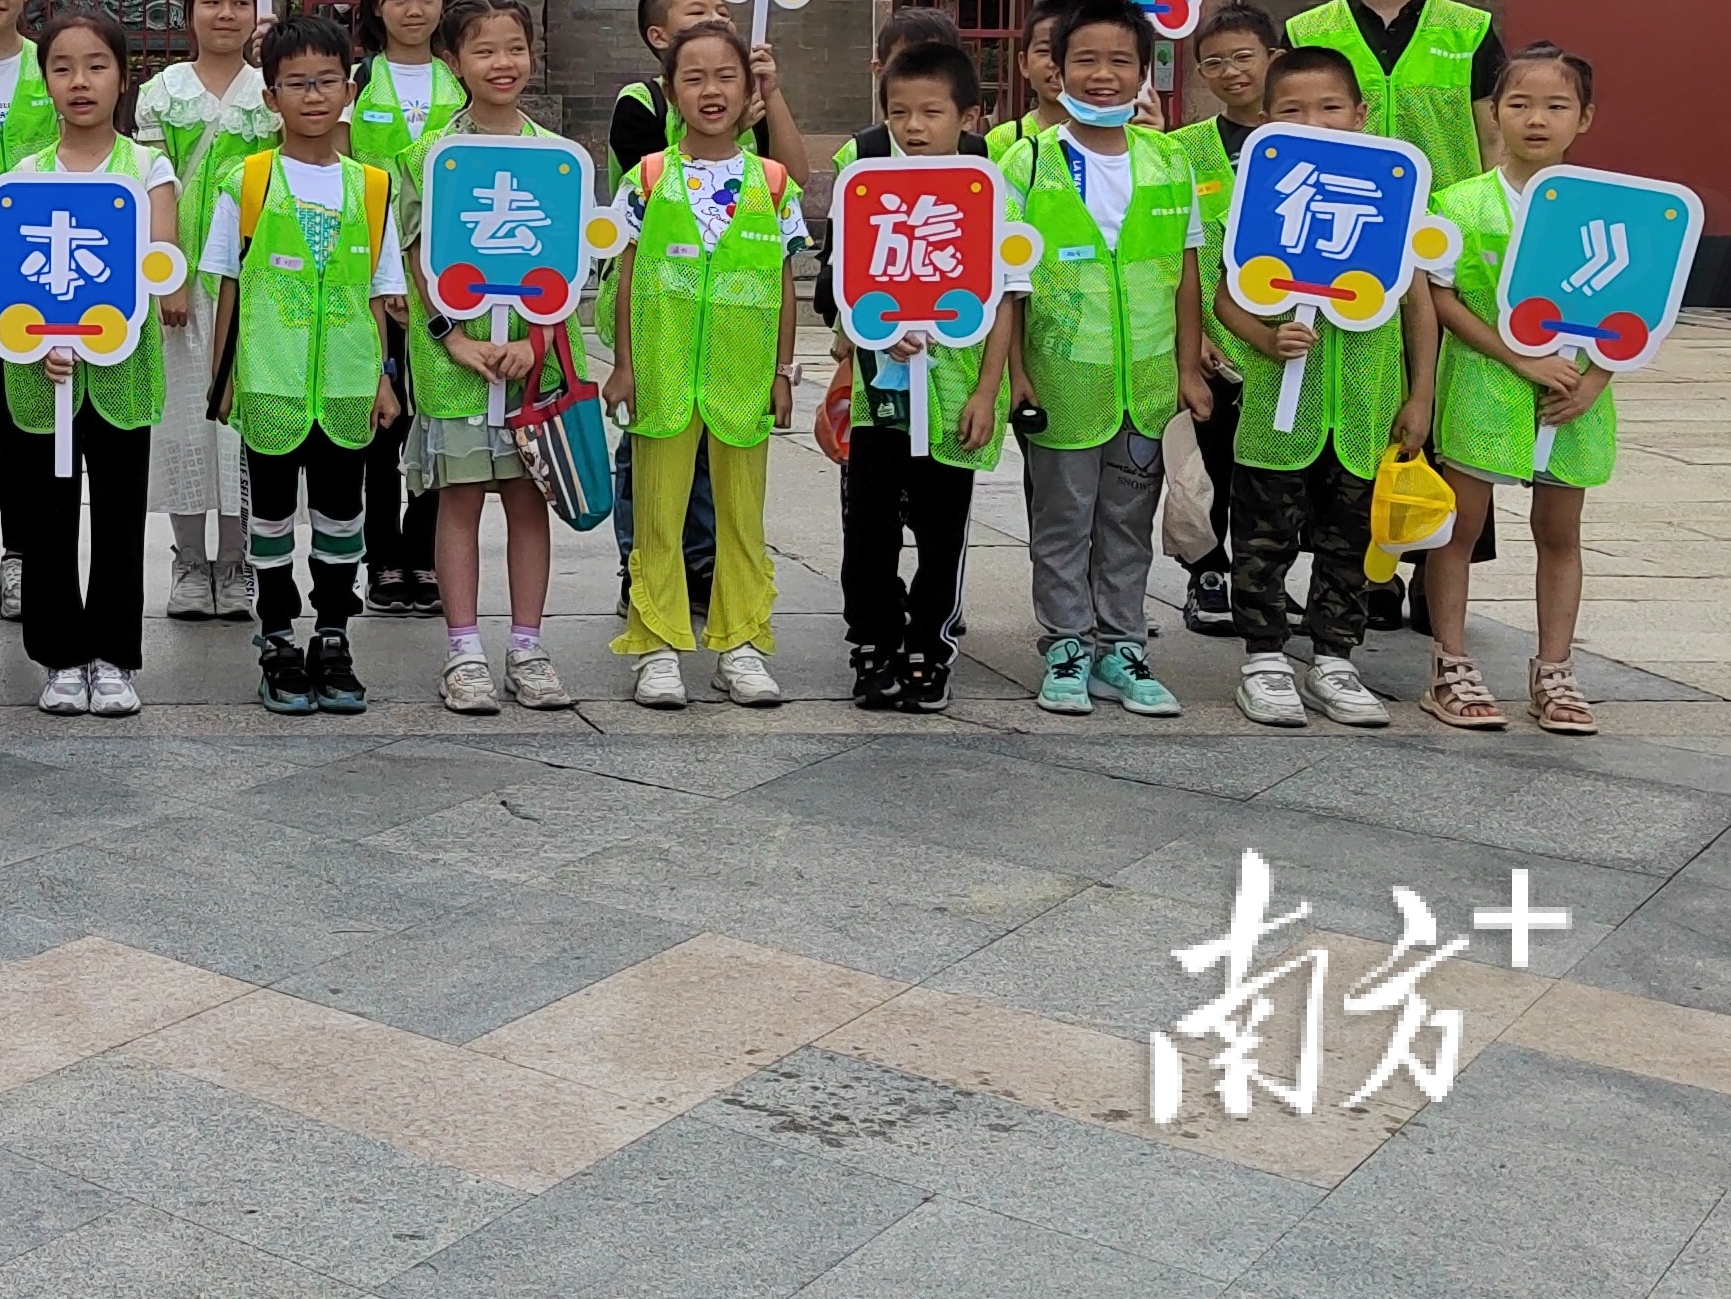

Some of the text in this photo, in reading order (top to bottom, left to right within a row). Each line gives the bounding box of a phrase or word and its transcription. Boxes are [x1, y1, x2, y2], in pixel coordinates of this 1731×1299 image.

[20, 210, 111, 301] 本
[460, 171, 551, 256] 去
[869, 193, 964, 282] 旅
[1273, 161, 1384, 260] 行
